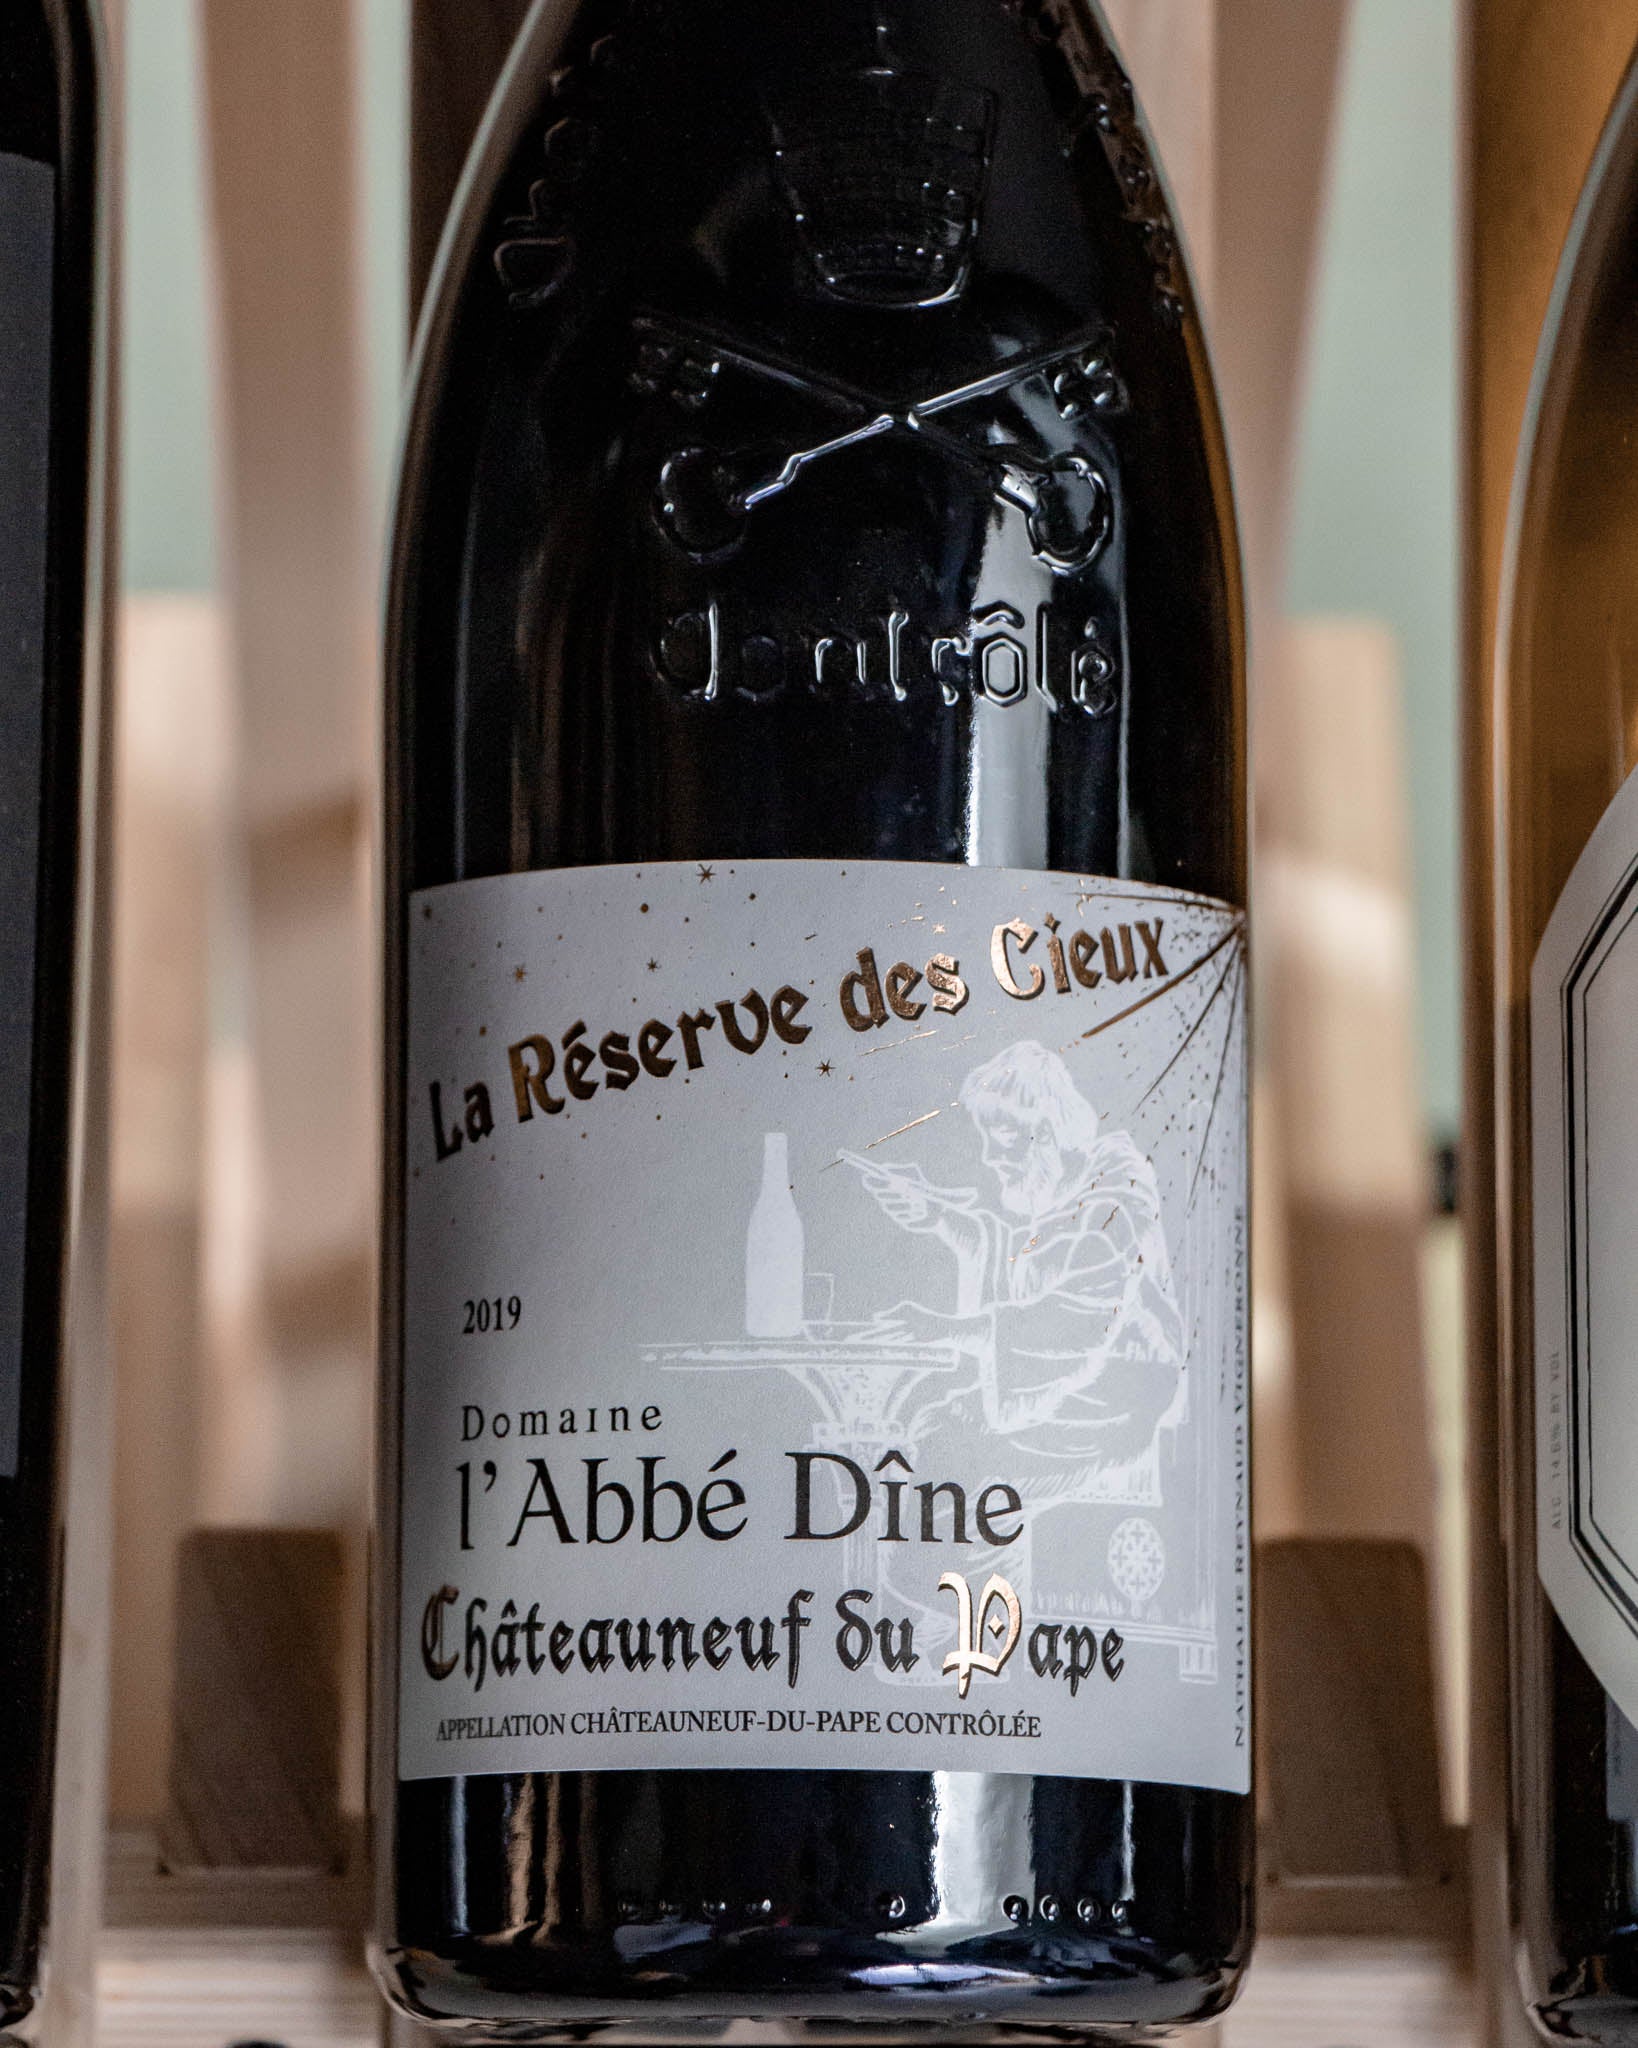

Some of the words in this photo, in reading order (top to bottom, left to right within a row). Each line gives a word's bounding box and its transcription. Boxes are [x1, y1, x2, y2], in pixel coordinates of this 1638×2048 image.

[429, 1080, 495, 1164] La
[507, 978, 814, 1124] Réserve
[839, 946, 969, 1033] des
[990, 911, 1168, 1001] Cieux
[463, 1295, 522, 1334] 2019
[1234, 1205, 1245, 1414] VIGNERONNE
[461, 1403, 663, 1441] Domaine
[783, 1449, 1026, 1547] Dîne
[1235, 1423, 1245, 1573] REYNAUD
[421, 1583, 816, 1693] Châteauneuf
[835, 1588, 920, 1674] du
[937, 1571, 1126, 1700] Pape
[1235, 1583, 1245, 1747] NATHALIE
[436, 1712, 565, 1742] APPELLATION
[570, 1705, 881, 1735] CHÂTEAUNEUF-DU-PAPE
[886, 1708, 1042, 1739] CONTRÔLÉE
